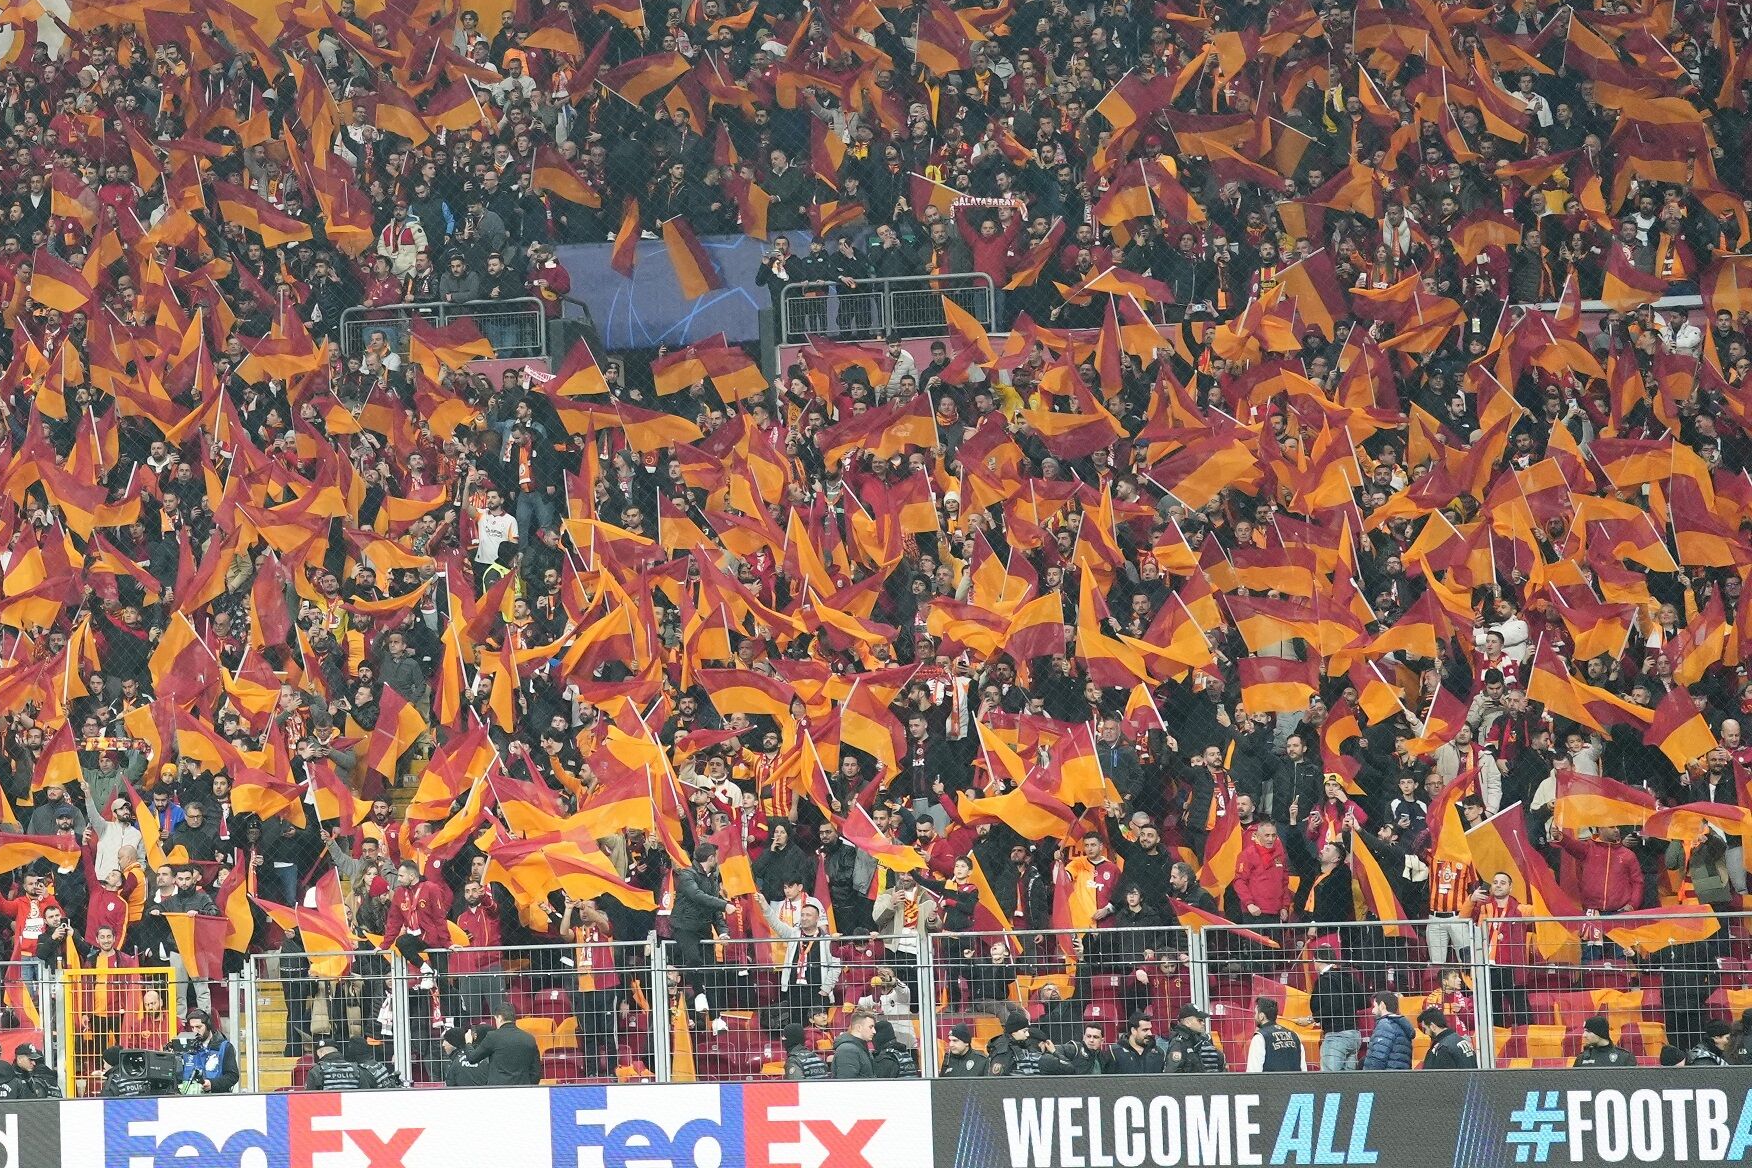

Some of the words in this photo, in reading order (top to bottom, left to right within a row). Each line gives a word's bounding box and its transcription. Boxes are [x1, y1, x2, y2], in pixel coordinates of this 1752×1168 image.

[104, 1093, 427, 1168] FedEx
[550, 1082, 887, 1168] FedEx
[1003, 1092, 1263, 1168] WELCOME
[1269, 1091, 1380, 1166] ALL
